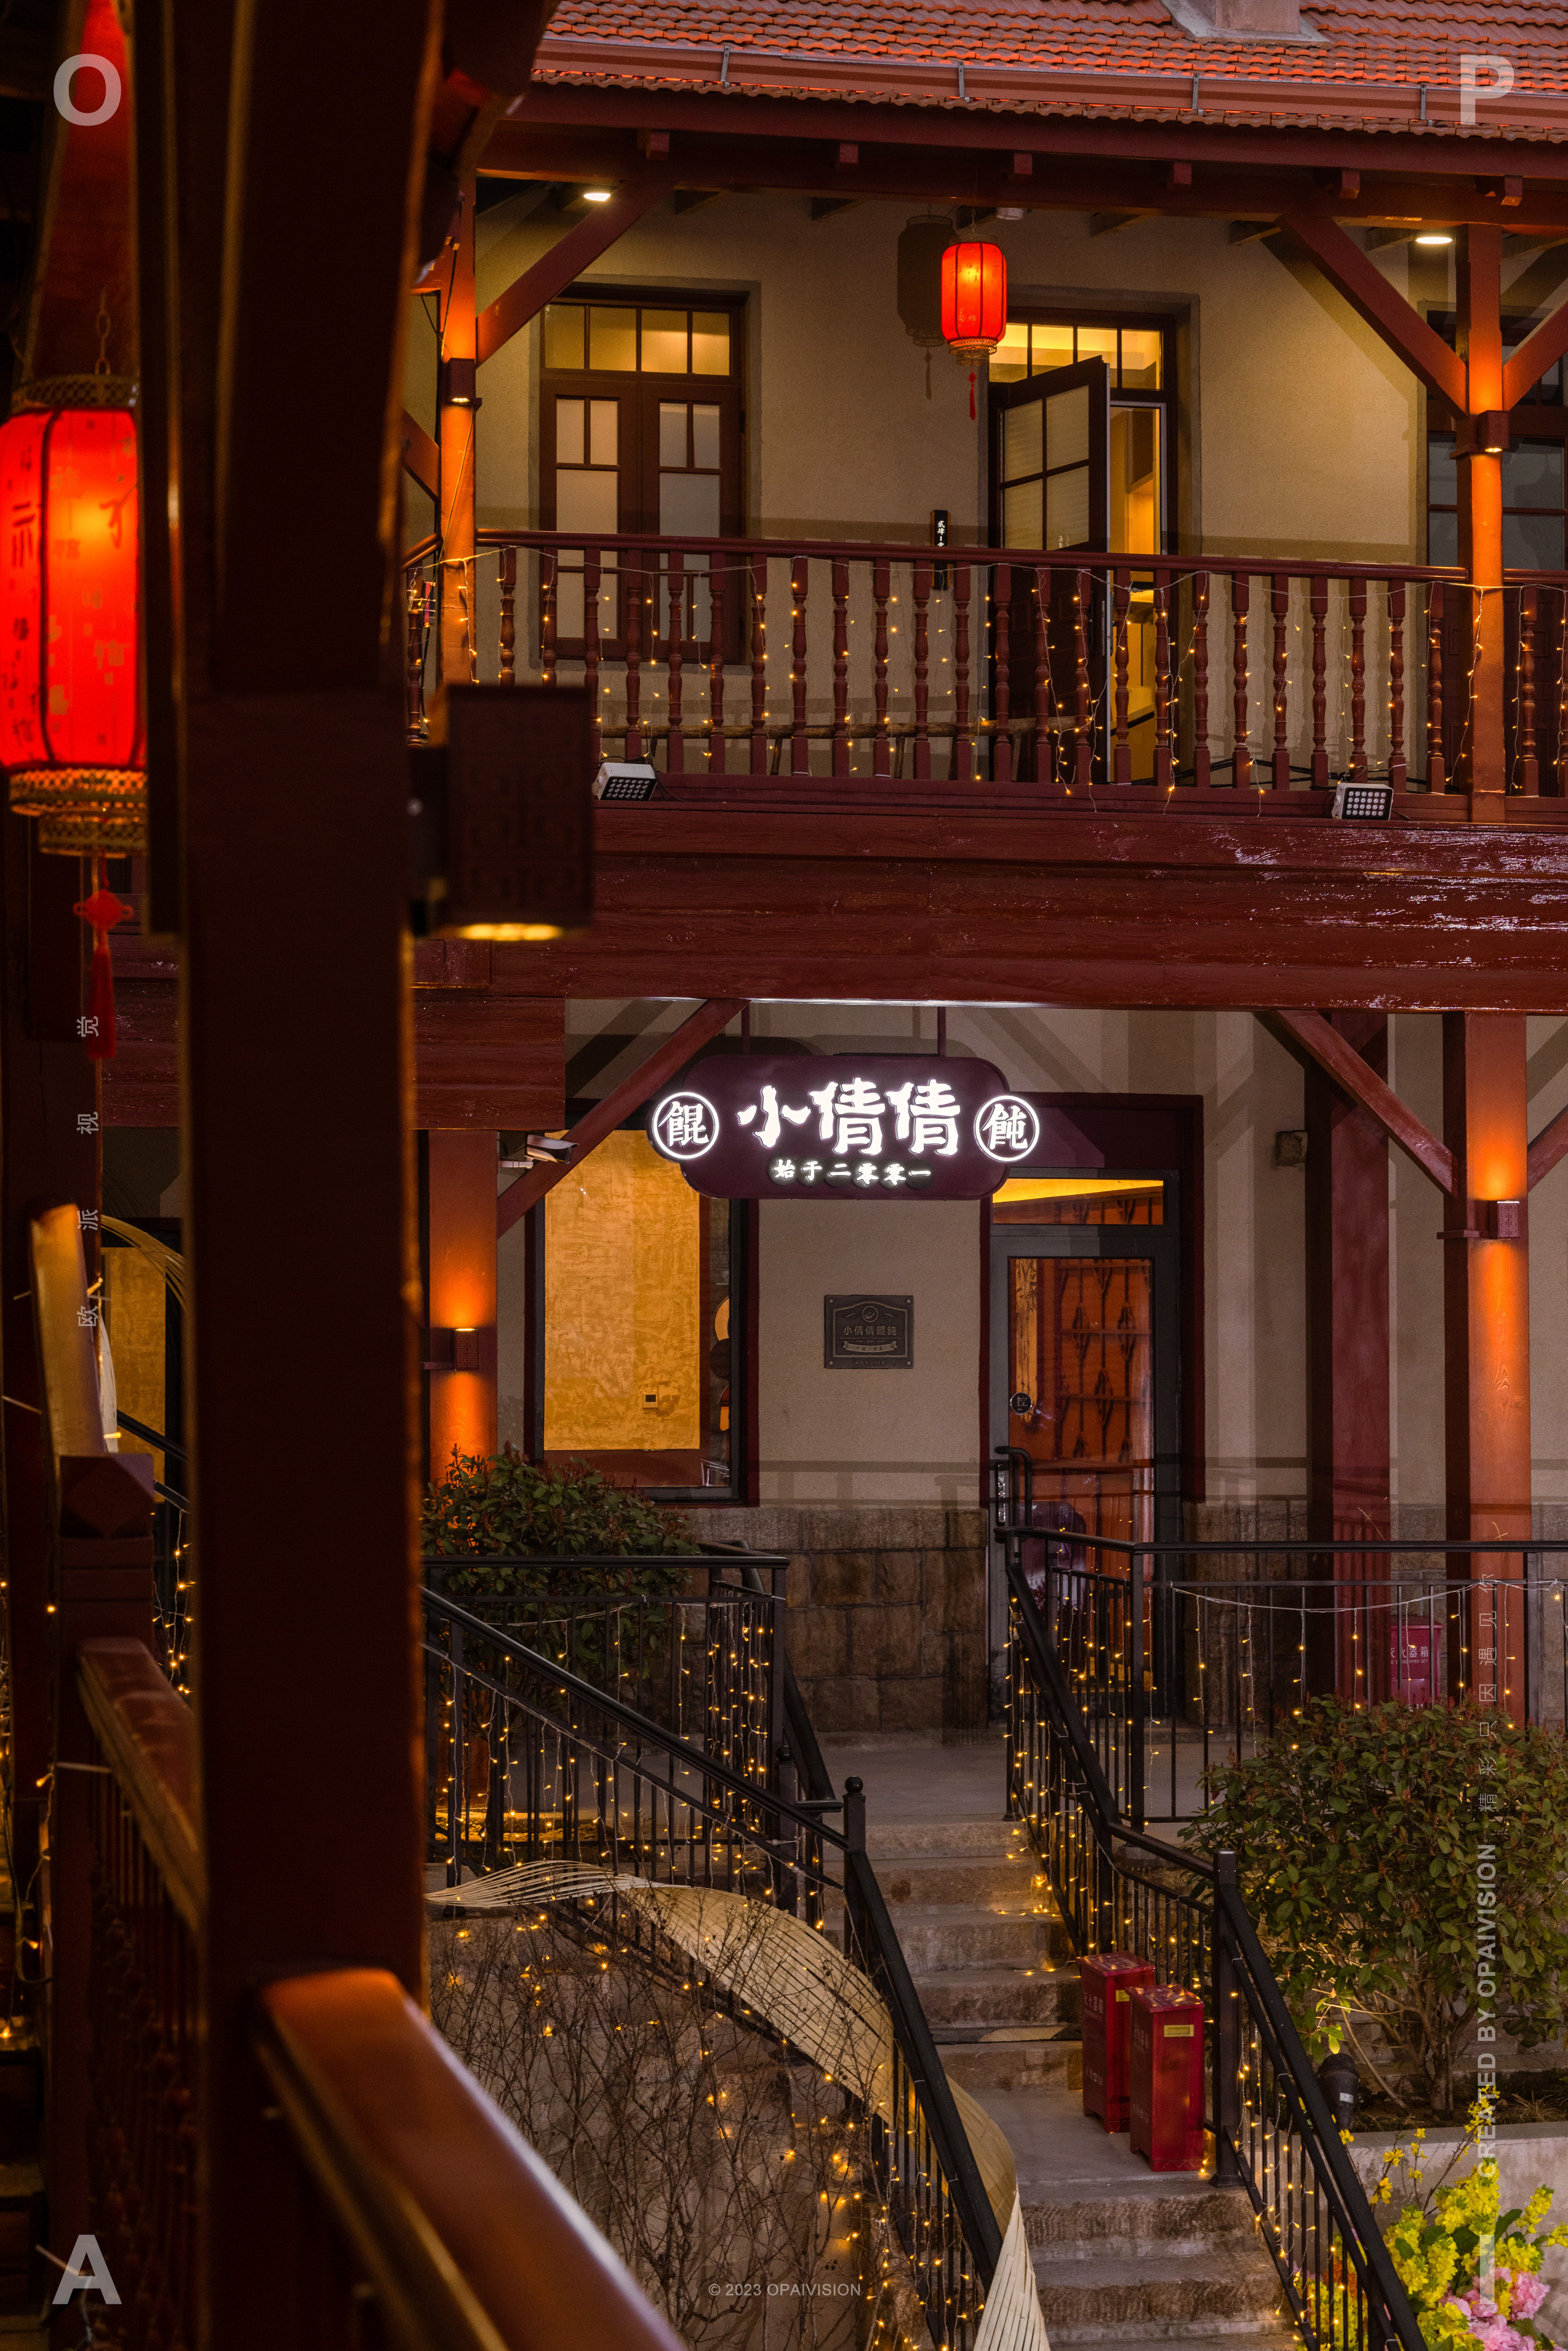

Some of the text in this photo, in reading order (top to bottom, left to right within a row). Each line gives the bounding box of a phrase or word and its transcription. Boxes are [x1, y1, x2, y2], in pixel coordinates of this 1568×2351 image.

[736, 1078, 961, 1156] 小倩倩
[773, 1159, 931, 1185] 始于二零零一
